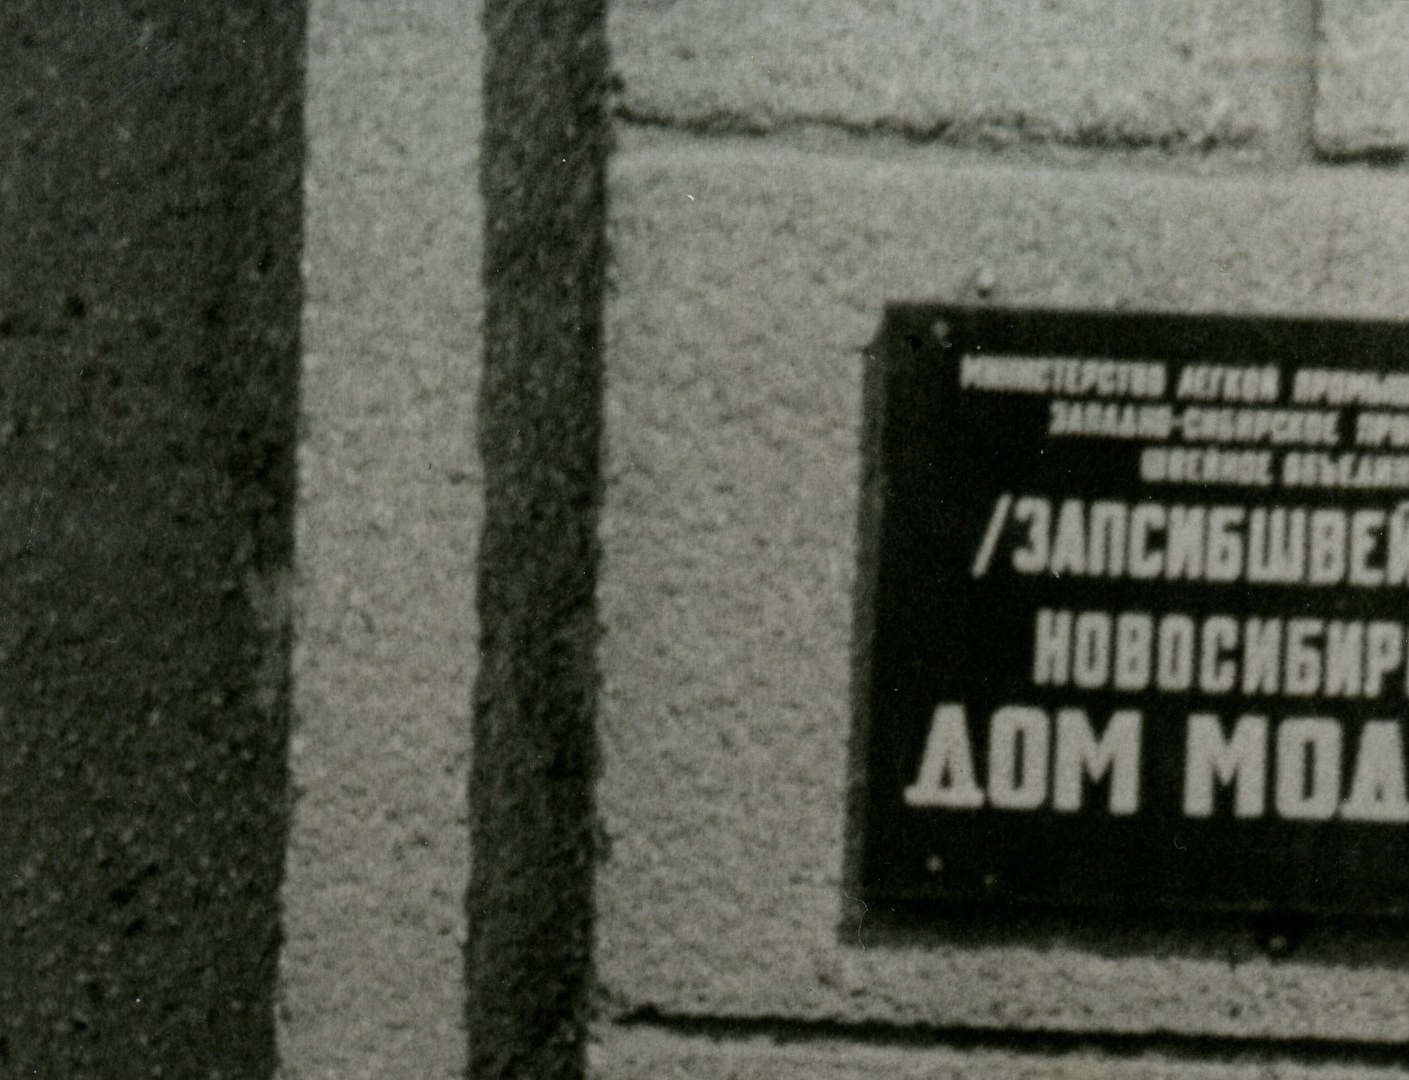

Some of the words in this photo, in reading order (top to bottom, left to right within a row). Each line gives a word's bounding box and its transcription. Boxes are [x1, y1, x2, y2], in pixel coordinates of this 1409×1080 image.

[1033, 608, 1409, 699] НОВОСИБИР
[904, 703, 1144, 816] ДОМ
[1181, 713, 1409, 824] МОД
